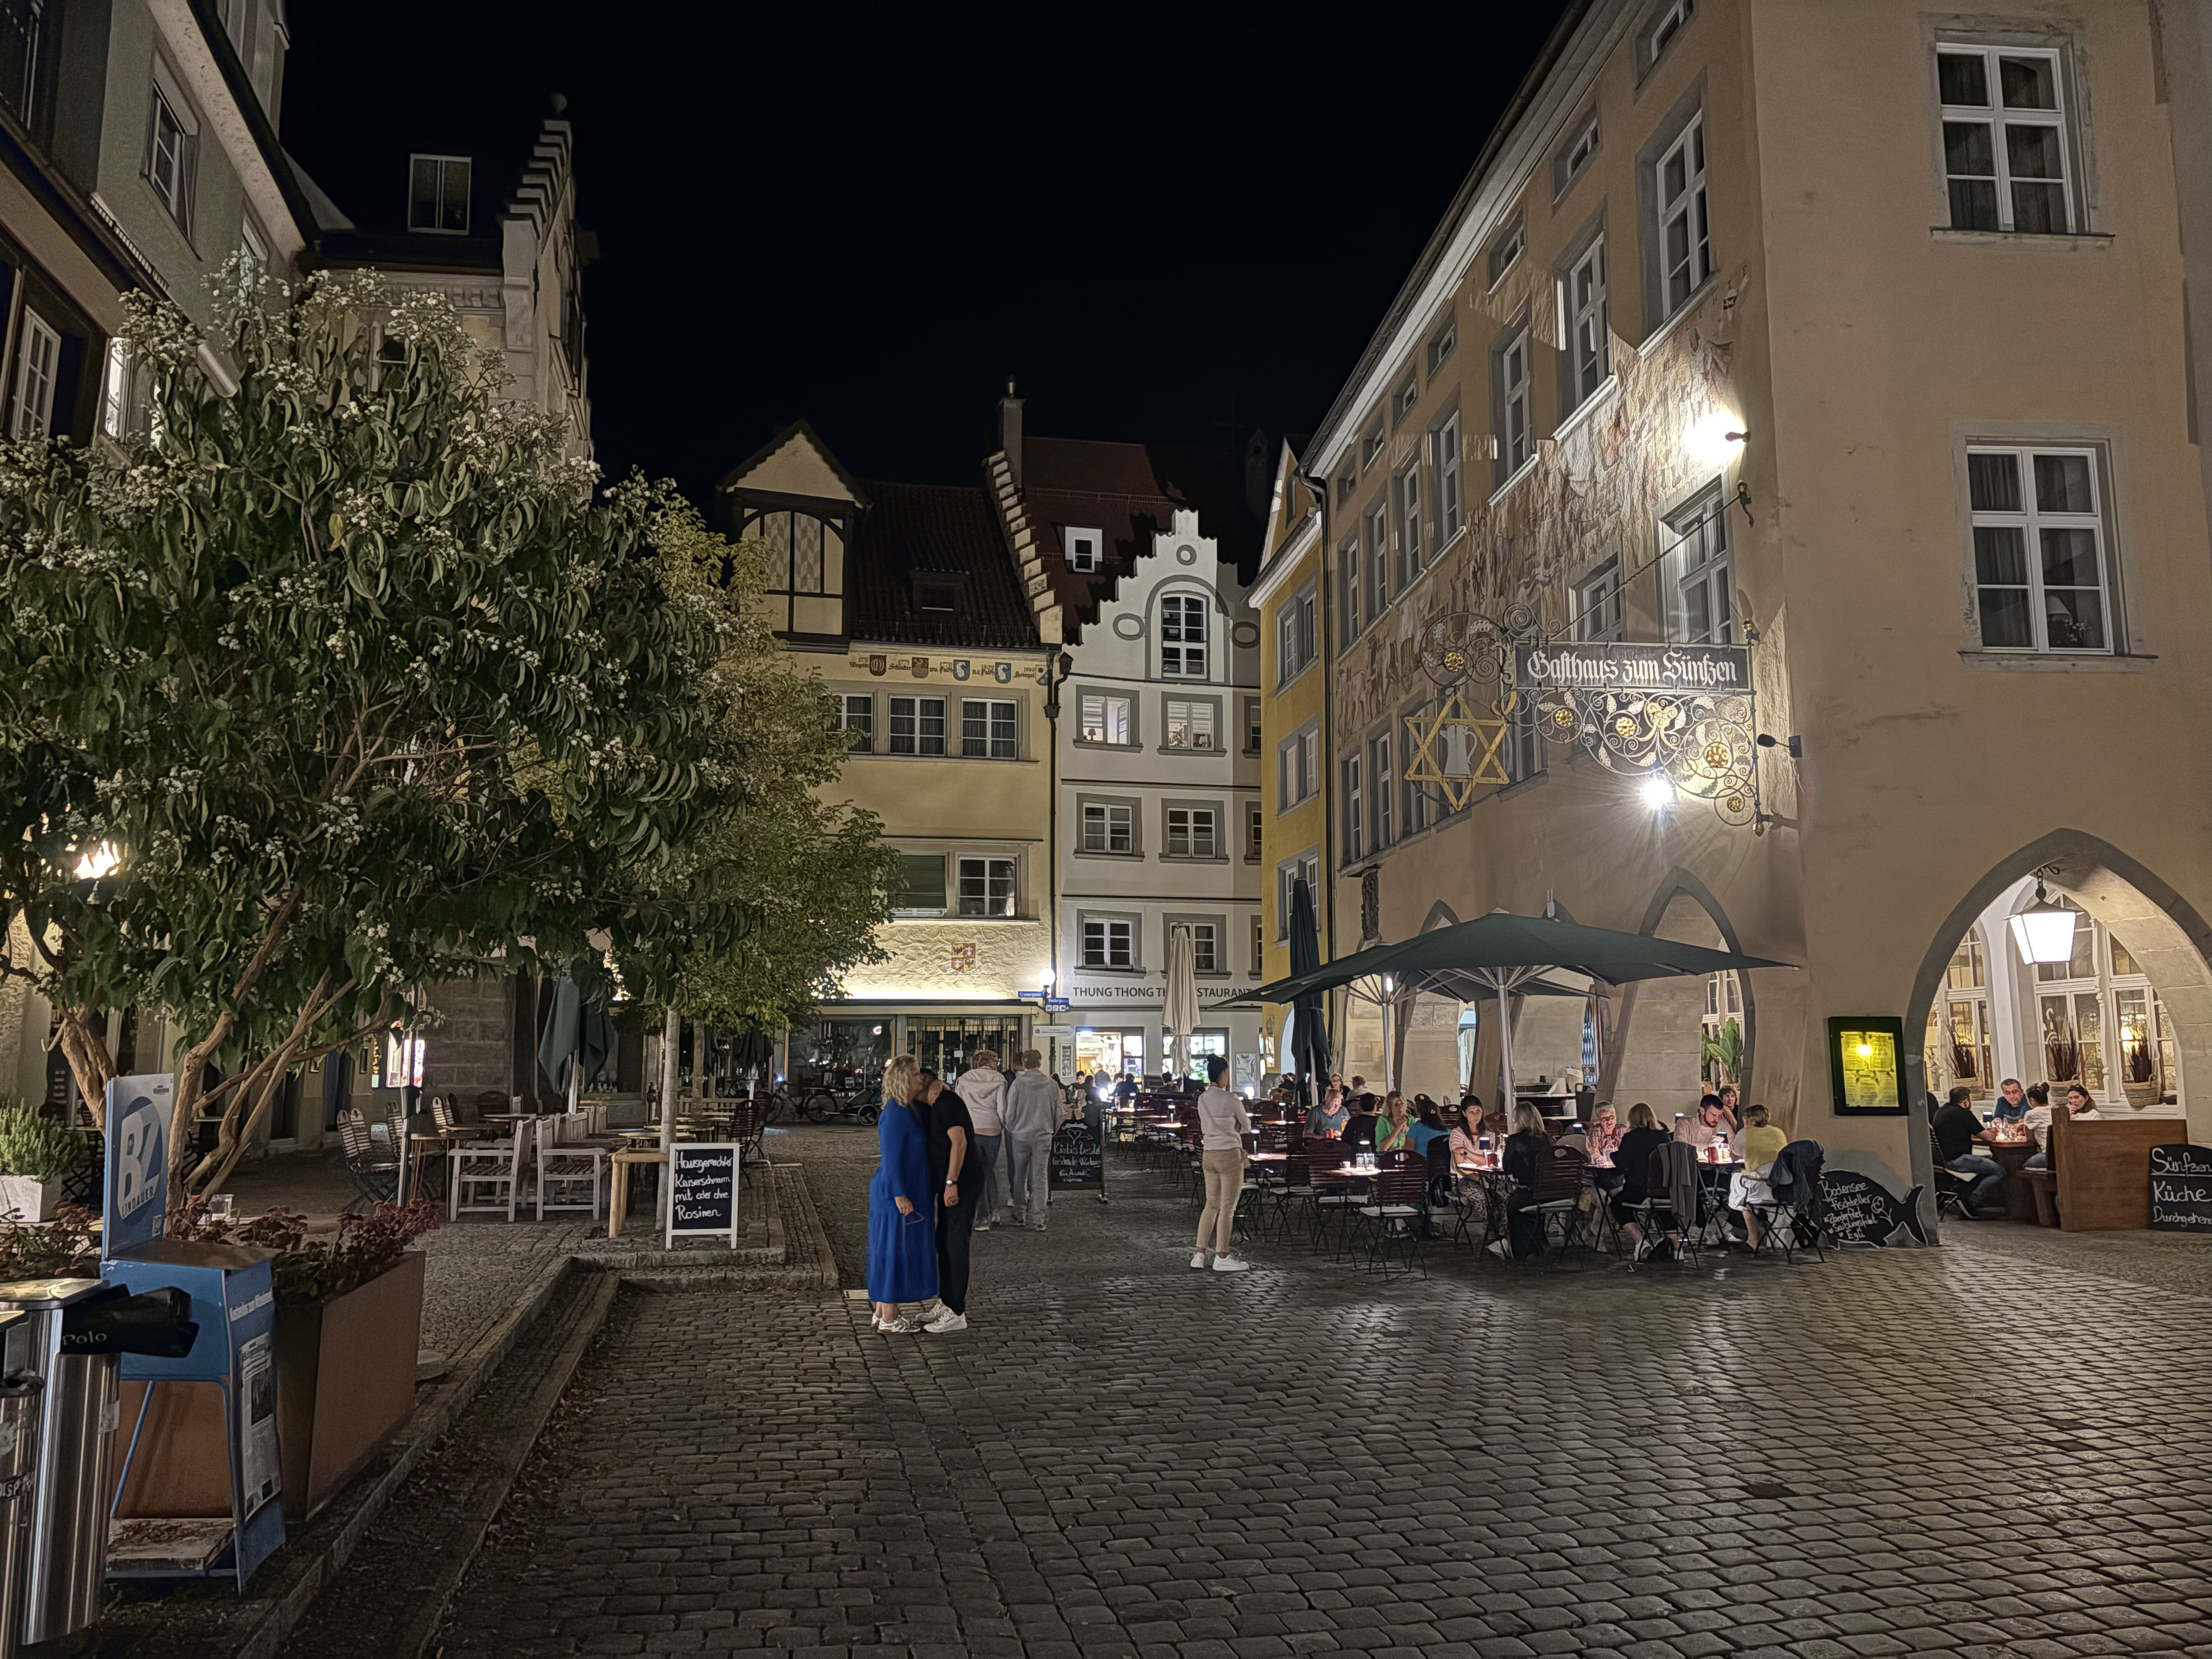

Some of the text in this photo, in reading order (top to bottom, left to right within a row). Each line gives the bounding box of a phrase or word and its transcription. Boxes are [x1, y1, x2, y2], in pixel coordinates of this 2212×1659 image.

[1527, 649, 1617, 684] Gasthaus
[1621, 658, 1660, 683] zum
[1073, 987, 1112, 997] THUNG
[1114, 987, 1154, 997] THONG
[1196, 988, 1253, 997] STAURANT
[118, 1102, 162, 1200] BZ
[121, 1185, 155, 1218] LINDAUER
[675, 1188, 693, 1203] mit
[696, 1190, 712, 1199] oder
[1817, 1180, 1869, 1203] Bodensee
[2153, 1180, 2212, 1202] Küche
[675, 1204, 722, 1221] Rosinen
[62, 1331, 107, 1345] Polo
